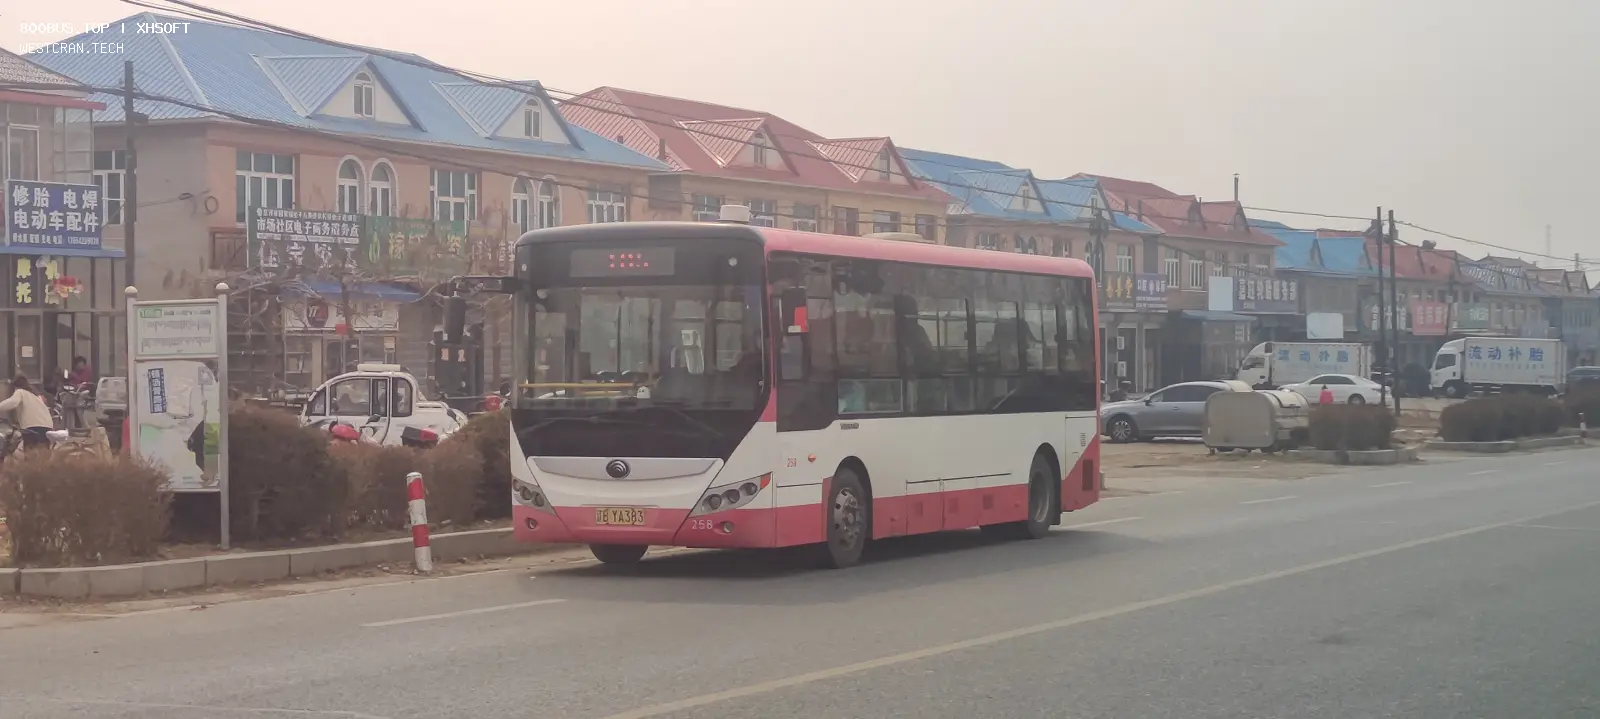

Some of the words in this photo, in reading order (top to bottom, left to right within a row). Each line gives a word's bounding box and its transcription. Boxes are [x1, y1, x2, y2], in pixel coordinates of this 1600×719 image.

[13, 185, 50, 208] 修胎
[63, 188, 98, 210] 电焊
[14, 208, 99, 233] 电动车配件
[256, 217, 360, 237] 市场社区电子商务服务点
[1468, 346, 1544, 361] 流动补胎
[691, 519, 714, 530] 258
